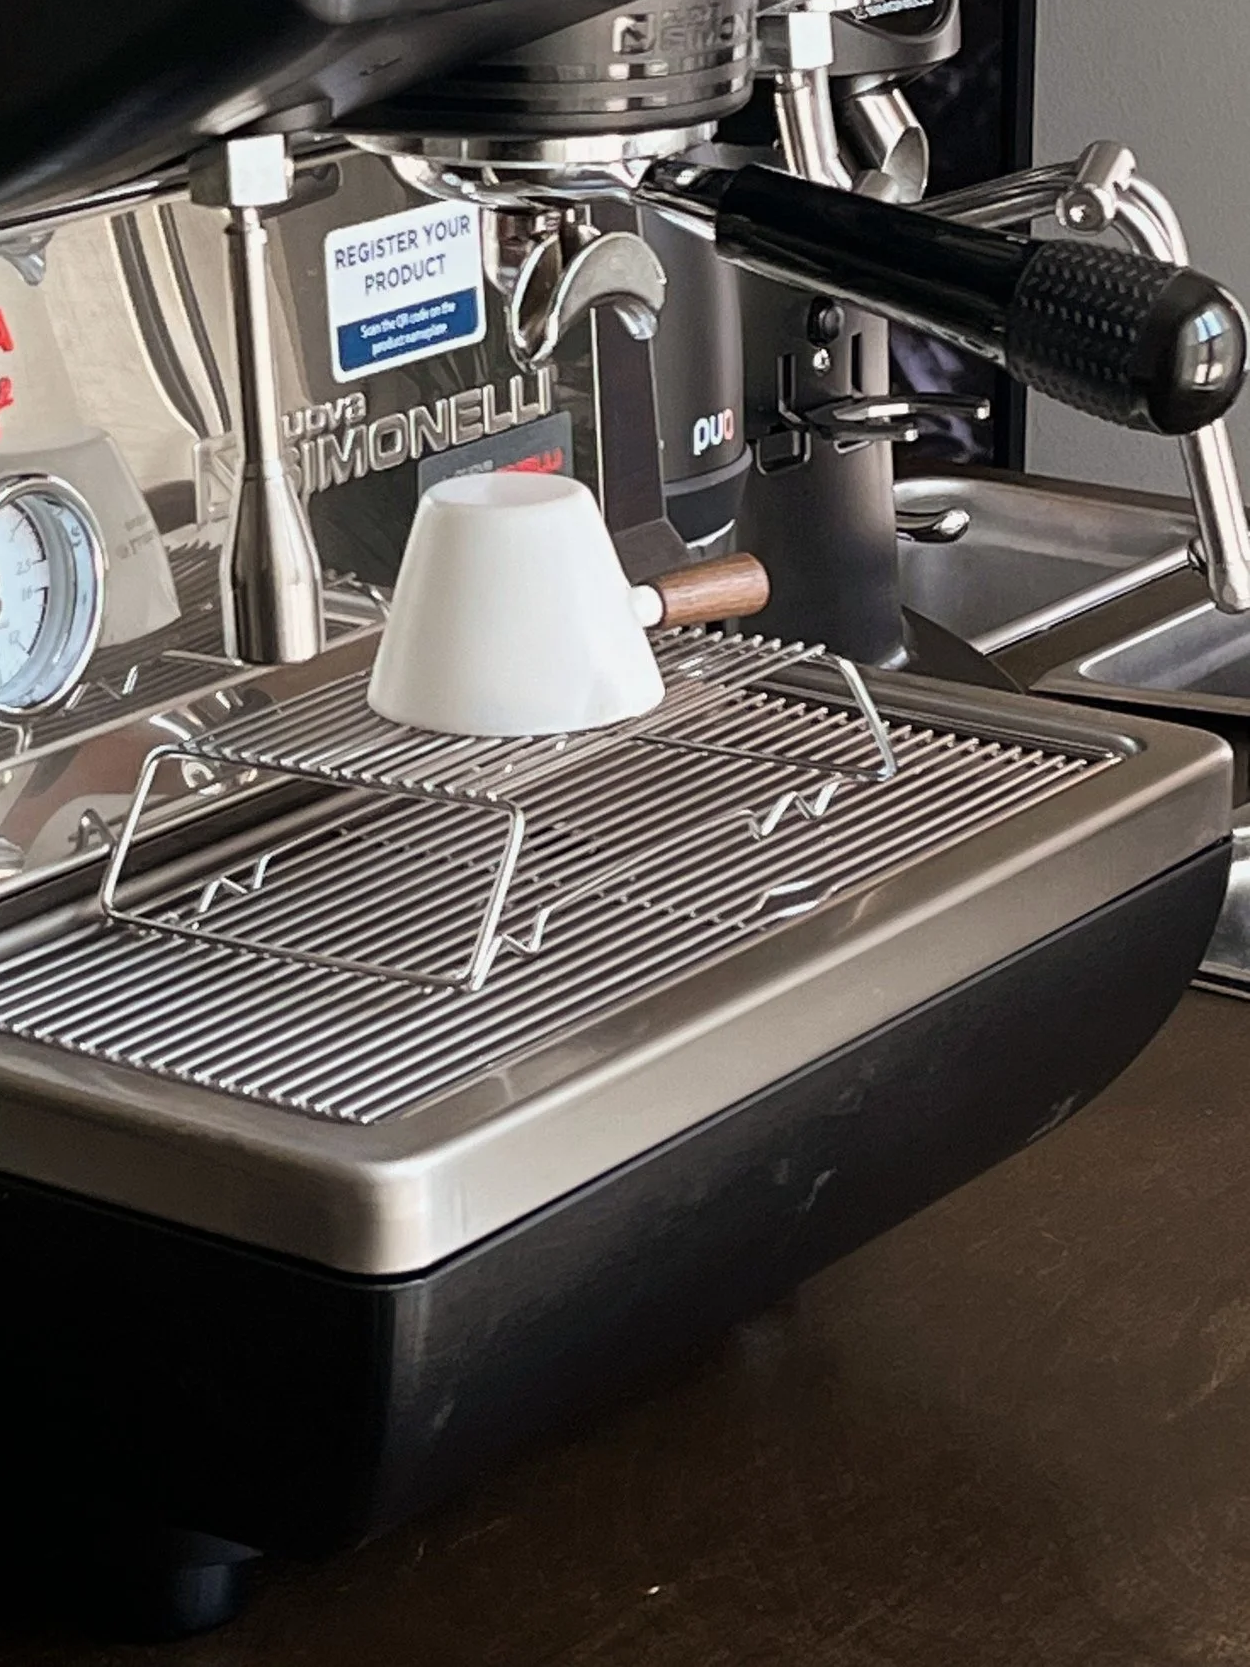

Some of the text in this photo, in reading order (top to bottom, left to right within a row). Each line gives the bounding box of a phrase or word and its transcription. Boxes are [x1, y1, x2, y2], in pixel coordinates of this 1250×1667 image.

[334, 214, 471, 270] REGISTER YOUR
[364, 253, 446, 297] PRODUCT
[281, 392, 366, 439] uova
